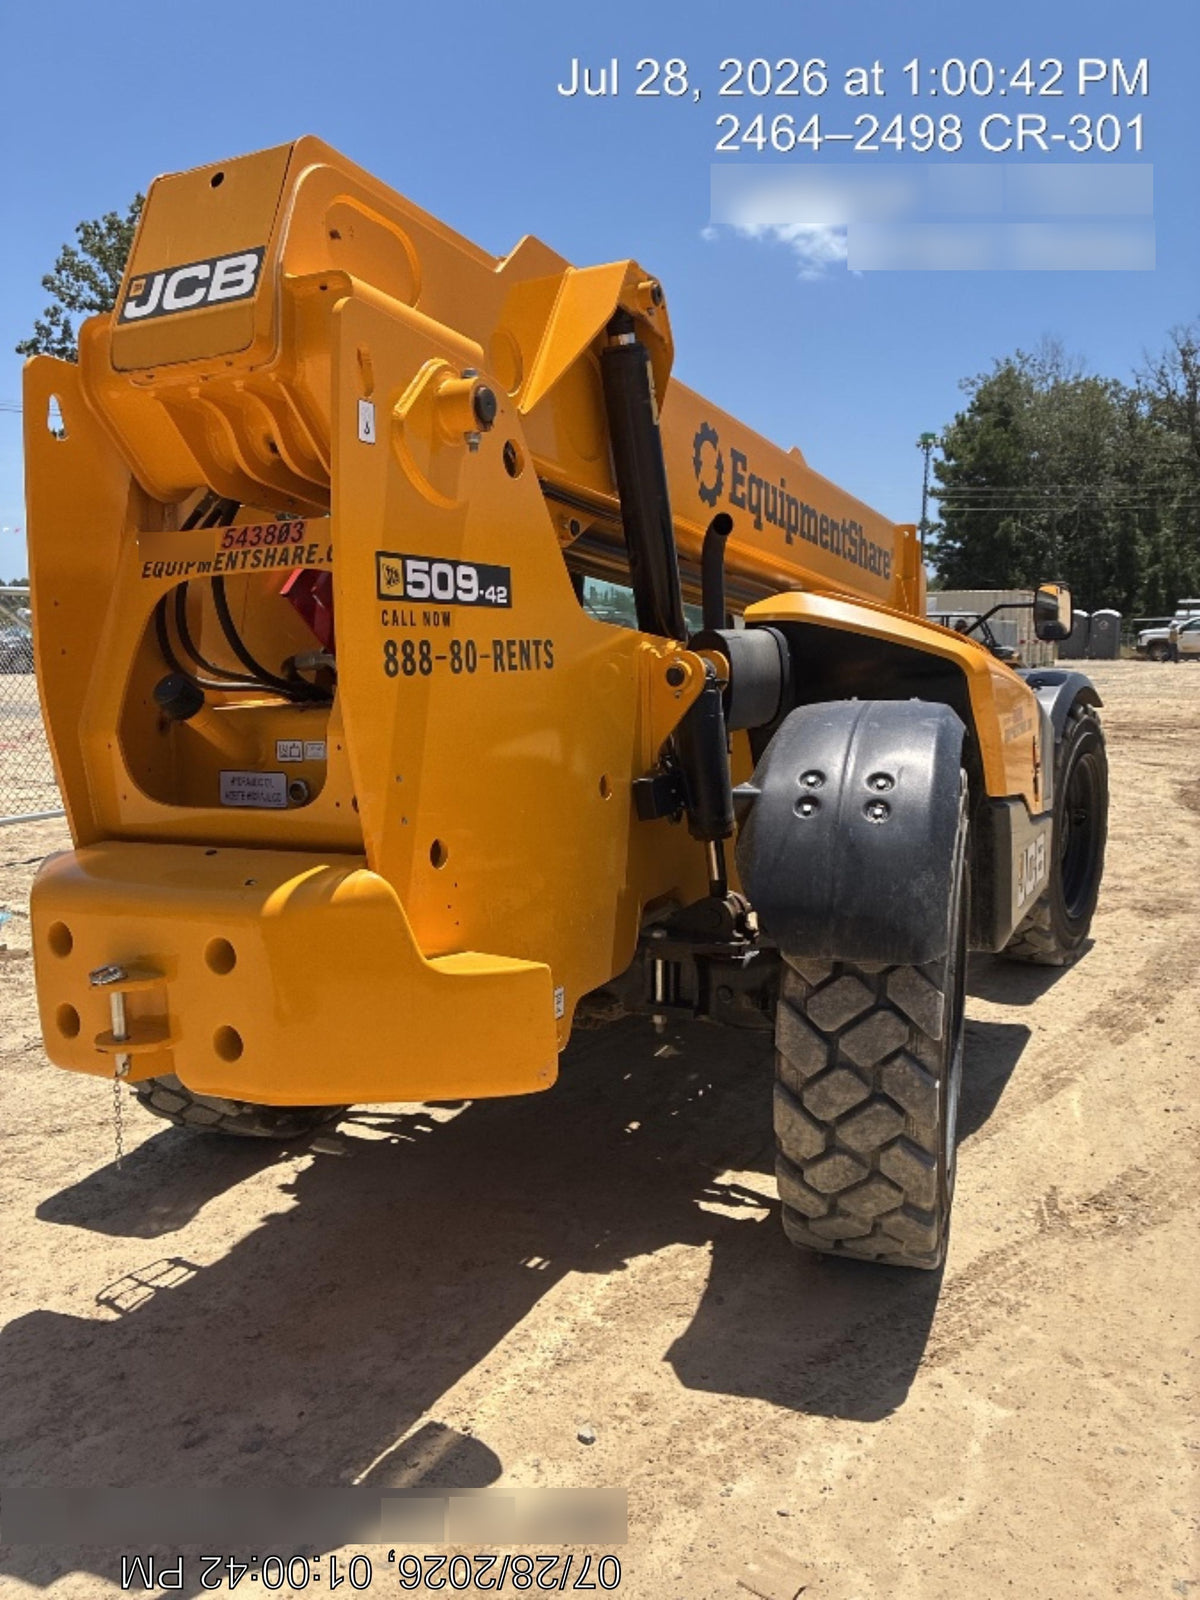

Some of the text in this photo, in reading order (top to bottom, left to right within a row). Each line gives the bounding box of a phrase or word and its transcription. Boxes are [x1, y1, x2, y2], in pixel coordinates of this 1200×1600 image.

[124, 253, 258, 319] JCB
[729, 447, 891, 581] EquipmentShare
[221, 521, 306, 549] 543803
[381, 609, 452, 628] CALL NOW
[383, 639, 554, 678] 888-80-RENTS
